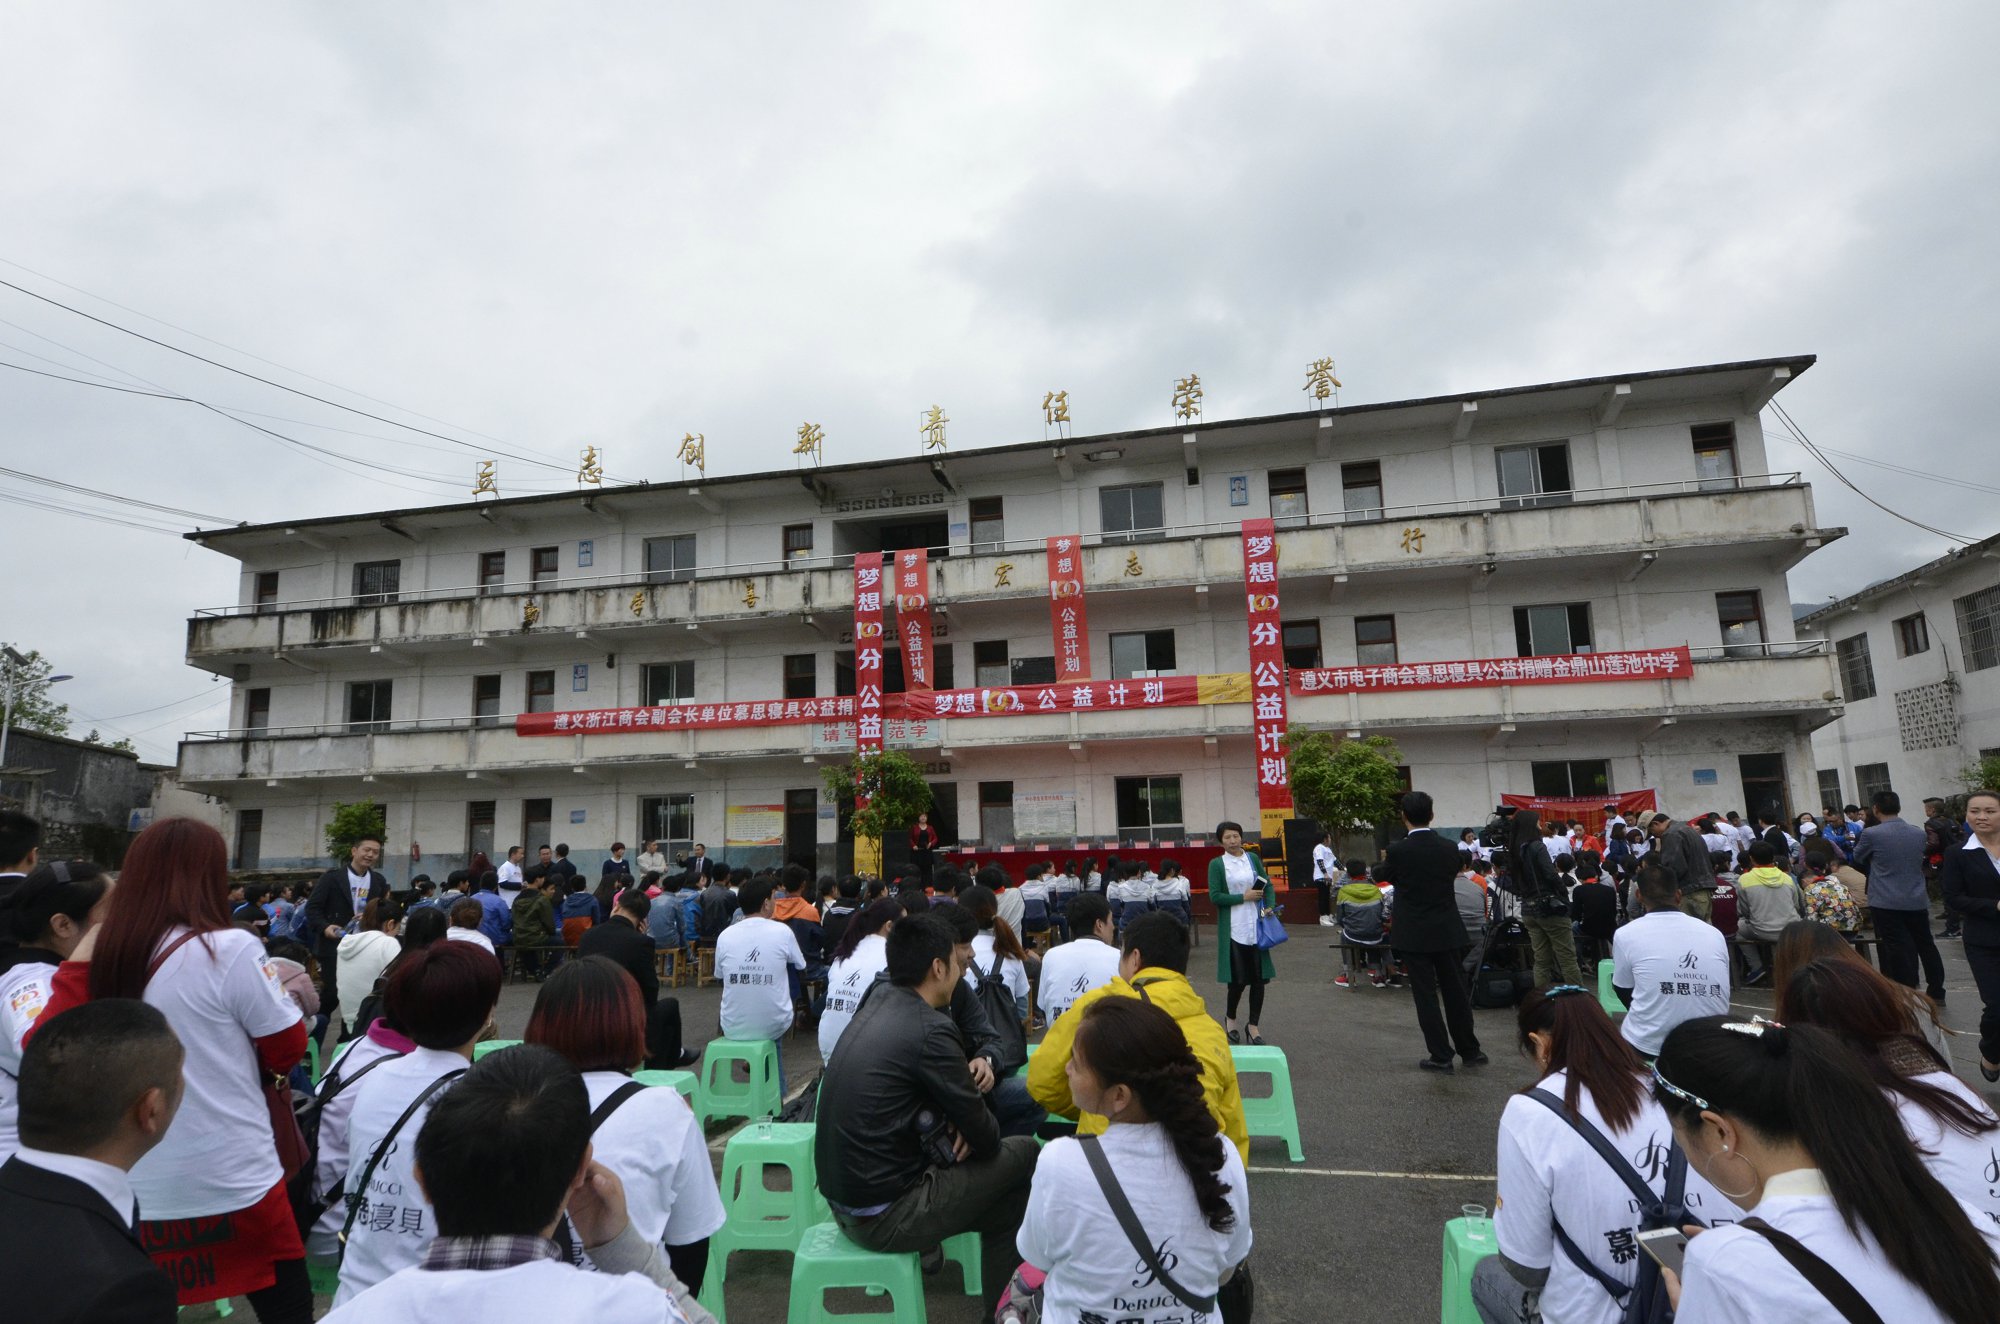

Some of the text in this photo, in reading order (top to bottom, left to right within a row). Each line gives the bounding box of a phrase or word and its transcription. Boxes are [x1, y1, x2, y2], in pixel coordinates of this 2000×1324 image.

[554, 698, 857, 730] 遵义浙江商会副会长单位慕思寝具公益捐
[1673, 972, 1708, 980] DeRUCCI
[1660, 981, 1722, 999] 慕思寝具
